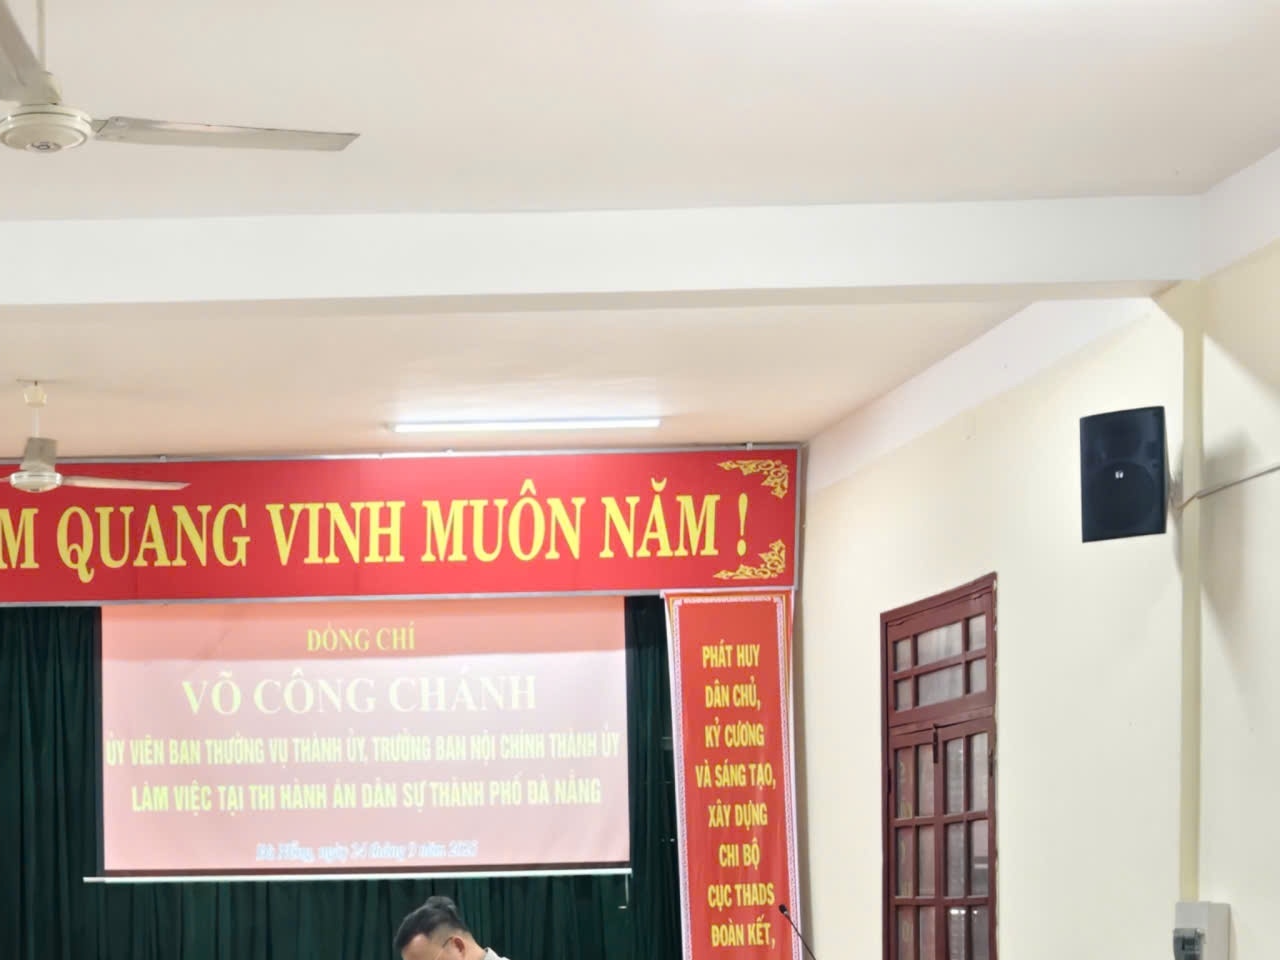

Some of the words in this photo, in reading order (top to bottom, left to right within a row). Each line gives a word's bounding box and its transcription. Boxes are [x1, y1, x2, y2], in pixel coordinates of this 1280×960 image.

[57, 503, 250, 583] QUANG
[266, 500, 405, 565] VINH
[422, 479, 584, 562] MUÔN
[600, 477, 719, 558] NĂM
[376, 621, 416, 651] CHÍ
[702, 639, 733, 668] PHÁT
[736, 644, 760, 667] HUY
[182, 670, 241, 716] VÕ
[254, 668, 376, 715] CÔNG
[389, 664, 537, 713] CHÁNH
[705, 679, 730, 708] DÂN
[732, 675, 761, 711] CHỦ,
[705, 716, 721, 748] KỶ
[724, 720, 765, 748] CƯƠNG
[169, 739, 201, 765] BAN
[436, 735, 466, 761] BAN
[695, 760, 712, 788] VÀ
[715, 759, 746, 788] SÁNG
[749, 762, 776, 791] TẠO,
[218, 785, 244, 816] TẠI
[249, 784, 275, 811] THI
[708, 799, 731, 828] XÂY
[734, 800, 768, 830] DỰNG
[718, 843, 740, 868] CHI
[742, 837, 761, 871] BỘ
[708, 884, 733, 912] CỤC
[735, 883, 775, 907] THADS
[711, 919, 745, 947] ĐOÀN
